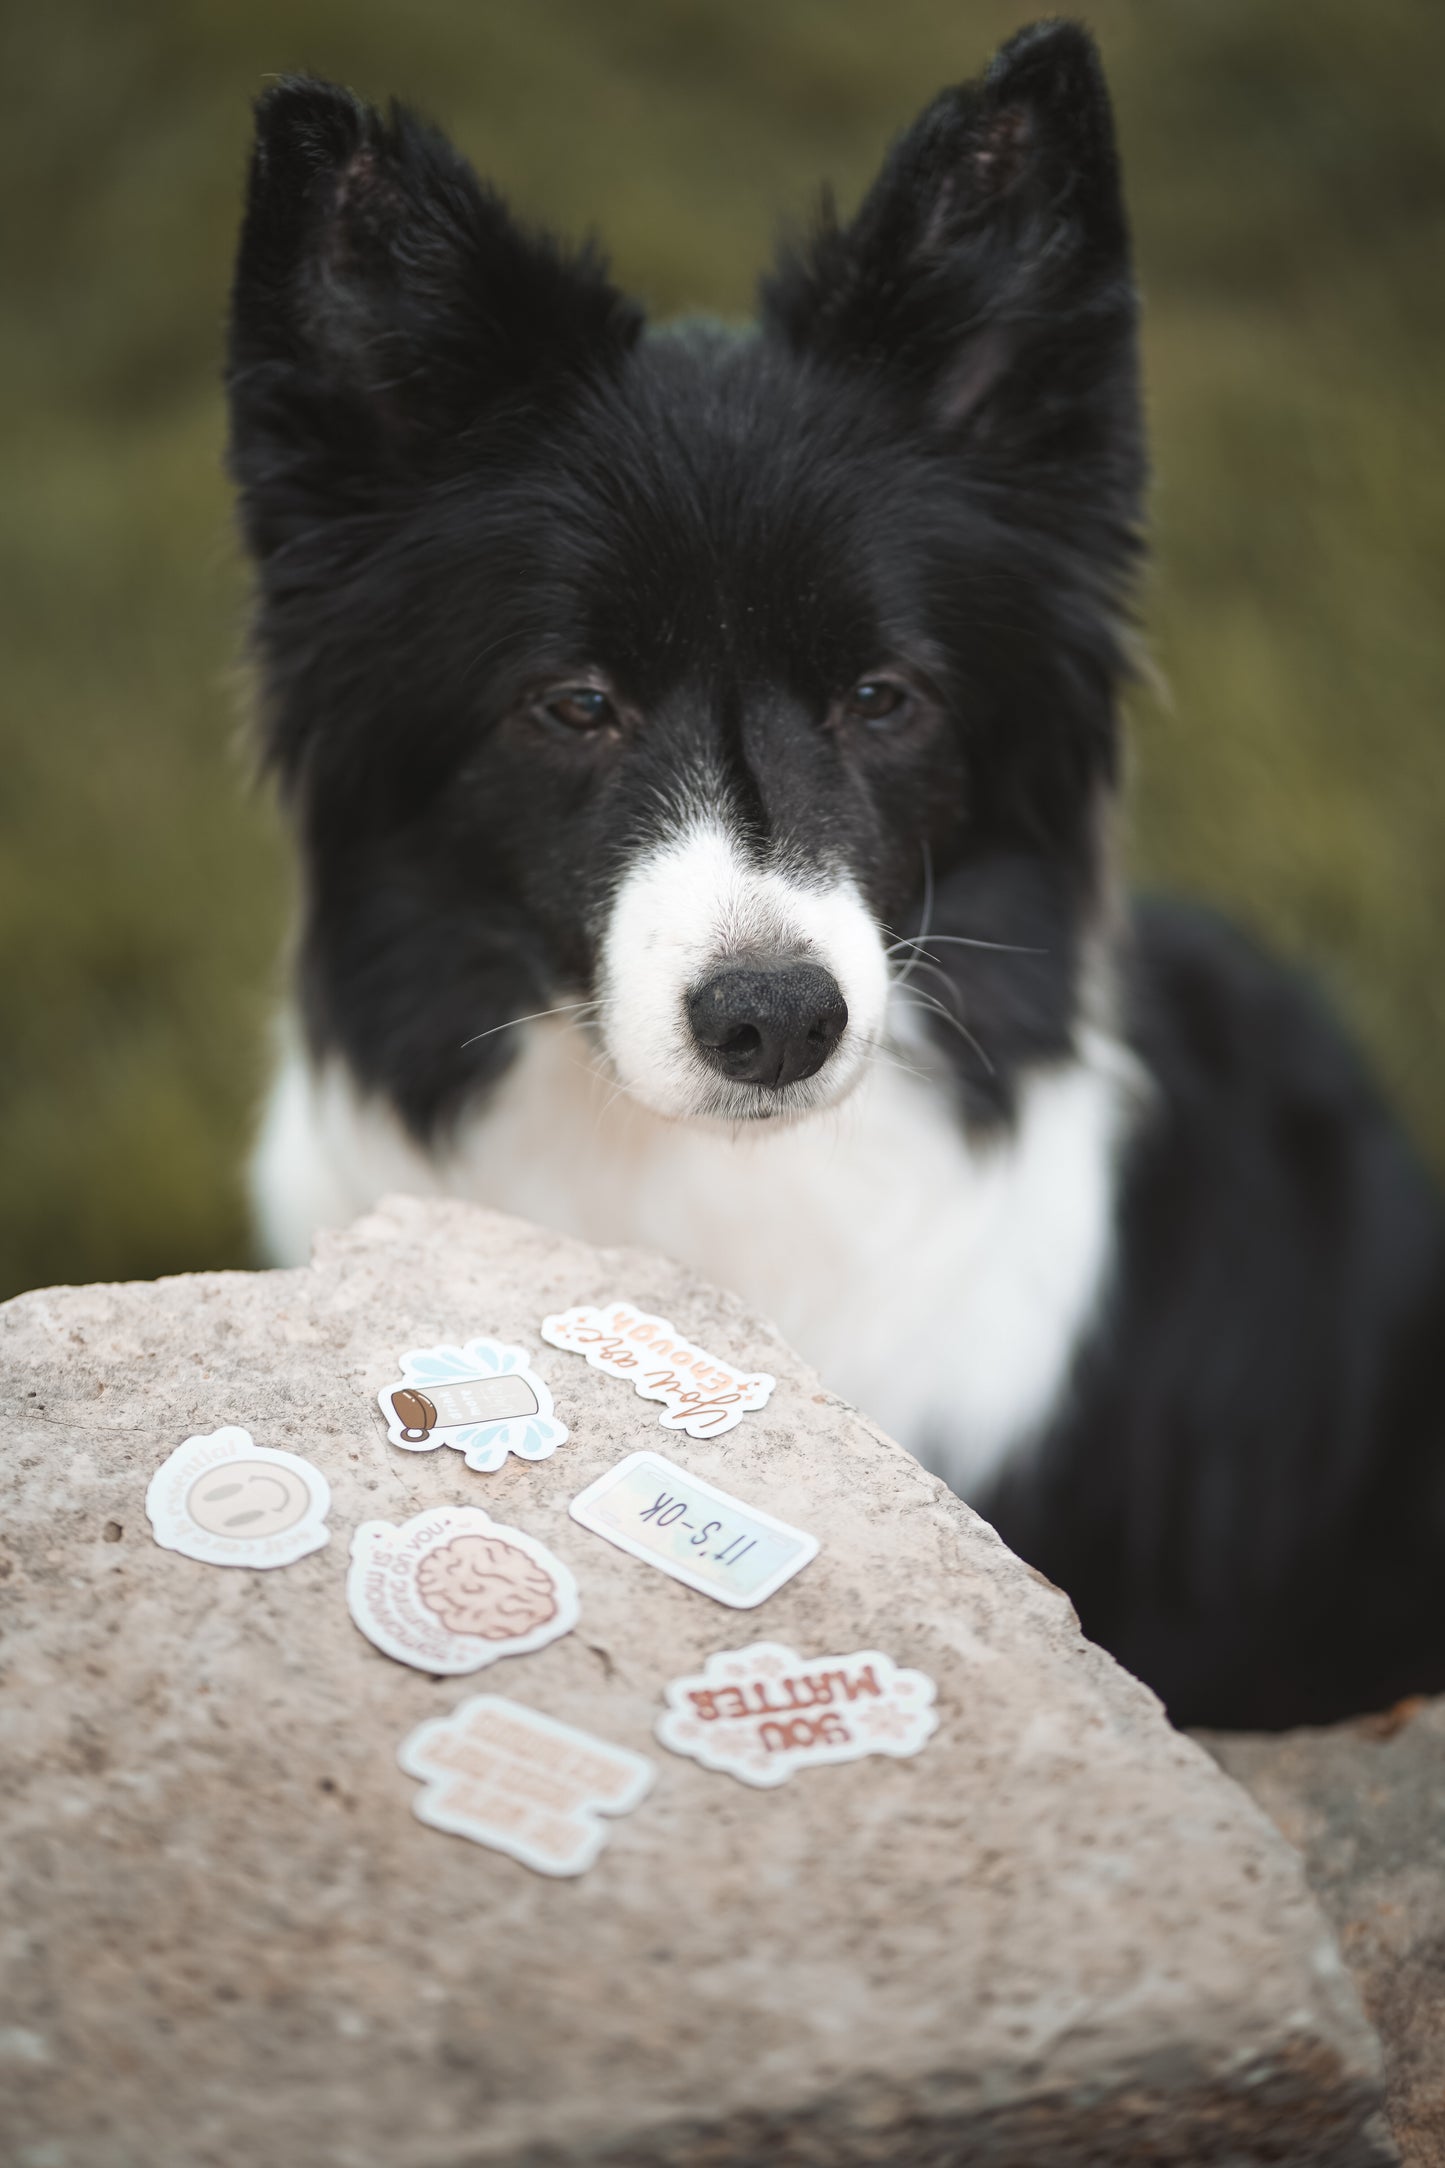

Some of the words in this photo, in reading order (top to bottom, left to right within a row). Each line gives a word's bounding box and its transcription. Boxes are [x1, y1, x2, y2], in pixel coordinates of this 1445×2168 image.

[573, 1327, 639, 1368] are
[613, 1312, 733, 1394] Enough
[644, 1371, 742, 1428] You
[688, 1665, 881, 1720] MATTER
[759, 1712, 851, 1752] YOU
